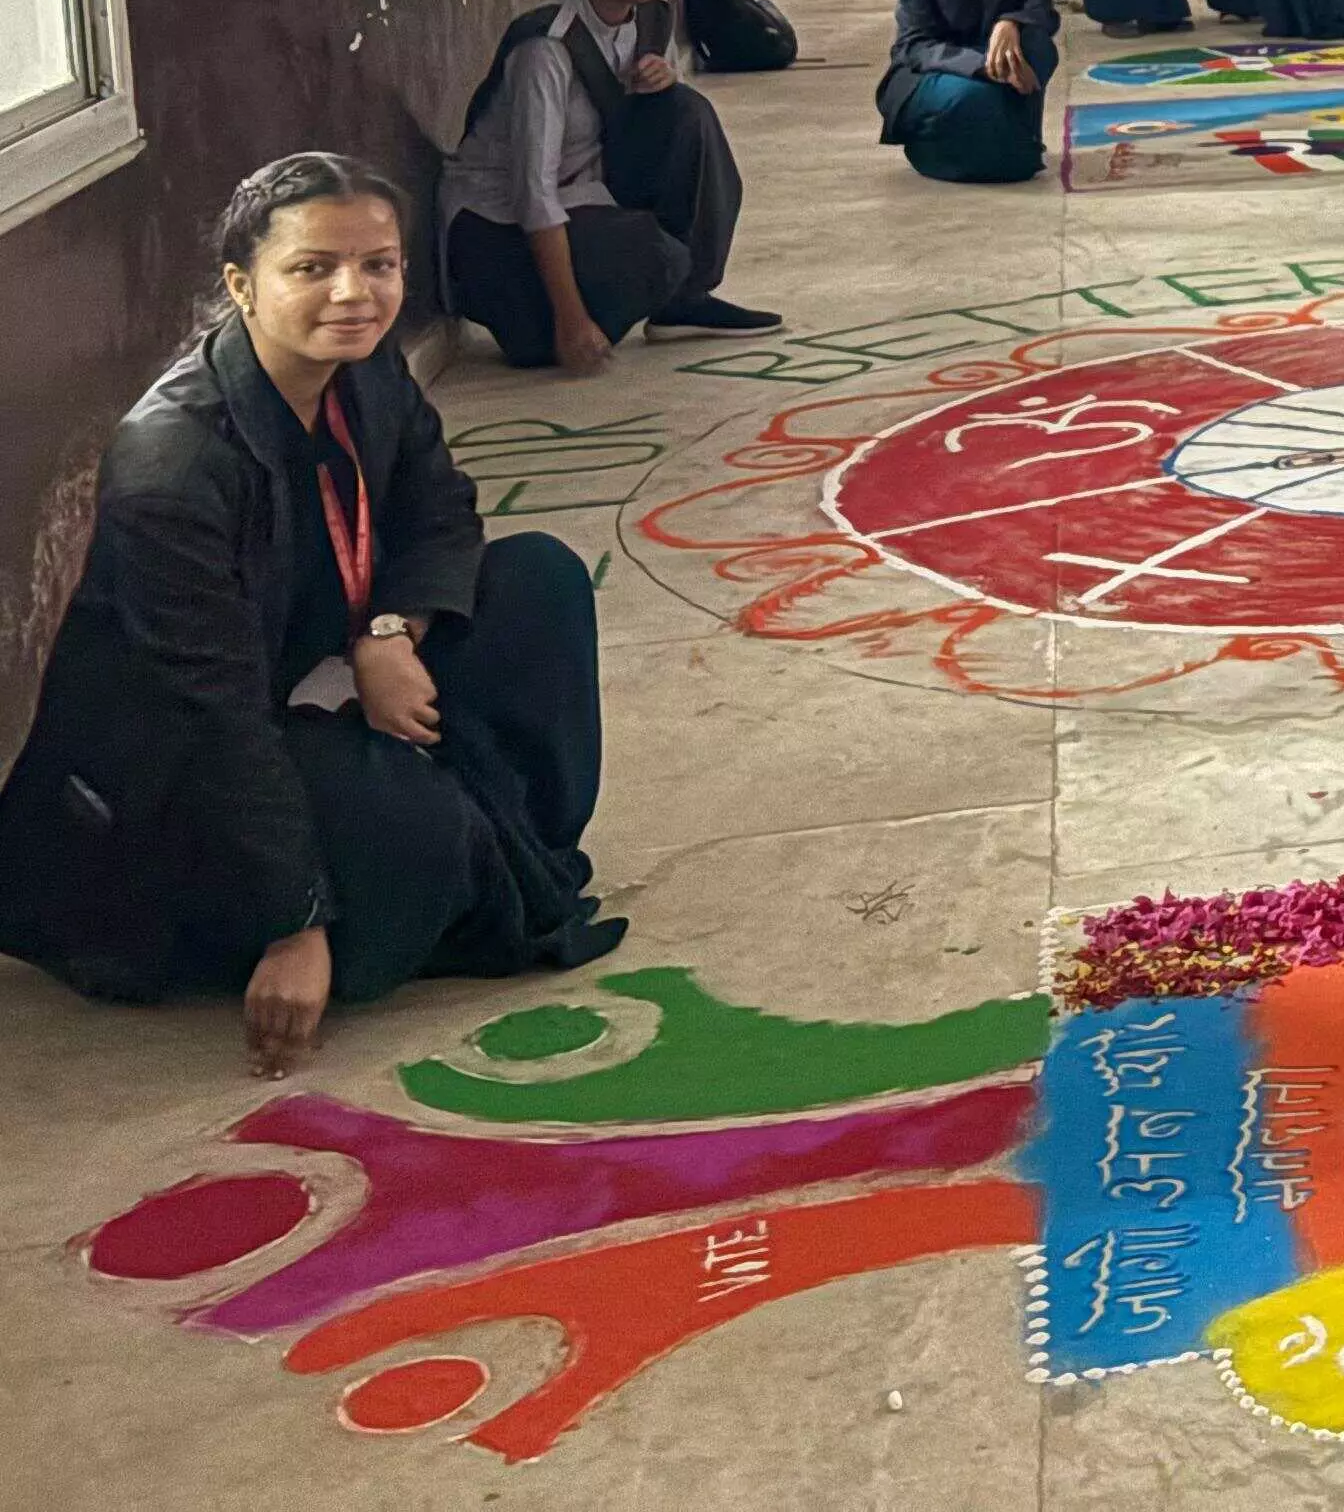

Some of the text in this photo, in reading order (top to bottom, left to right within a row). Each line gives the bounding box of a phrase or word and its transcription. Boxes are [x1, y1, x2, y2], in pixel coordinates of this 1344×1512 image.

[1063, 1012, 1197, 1334] जागो अब प्यारे
[1227, 1064, 1335, 1224] मतदाता
